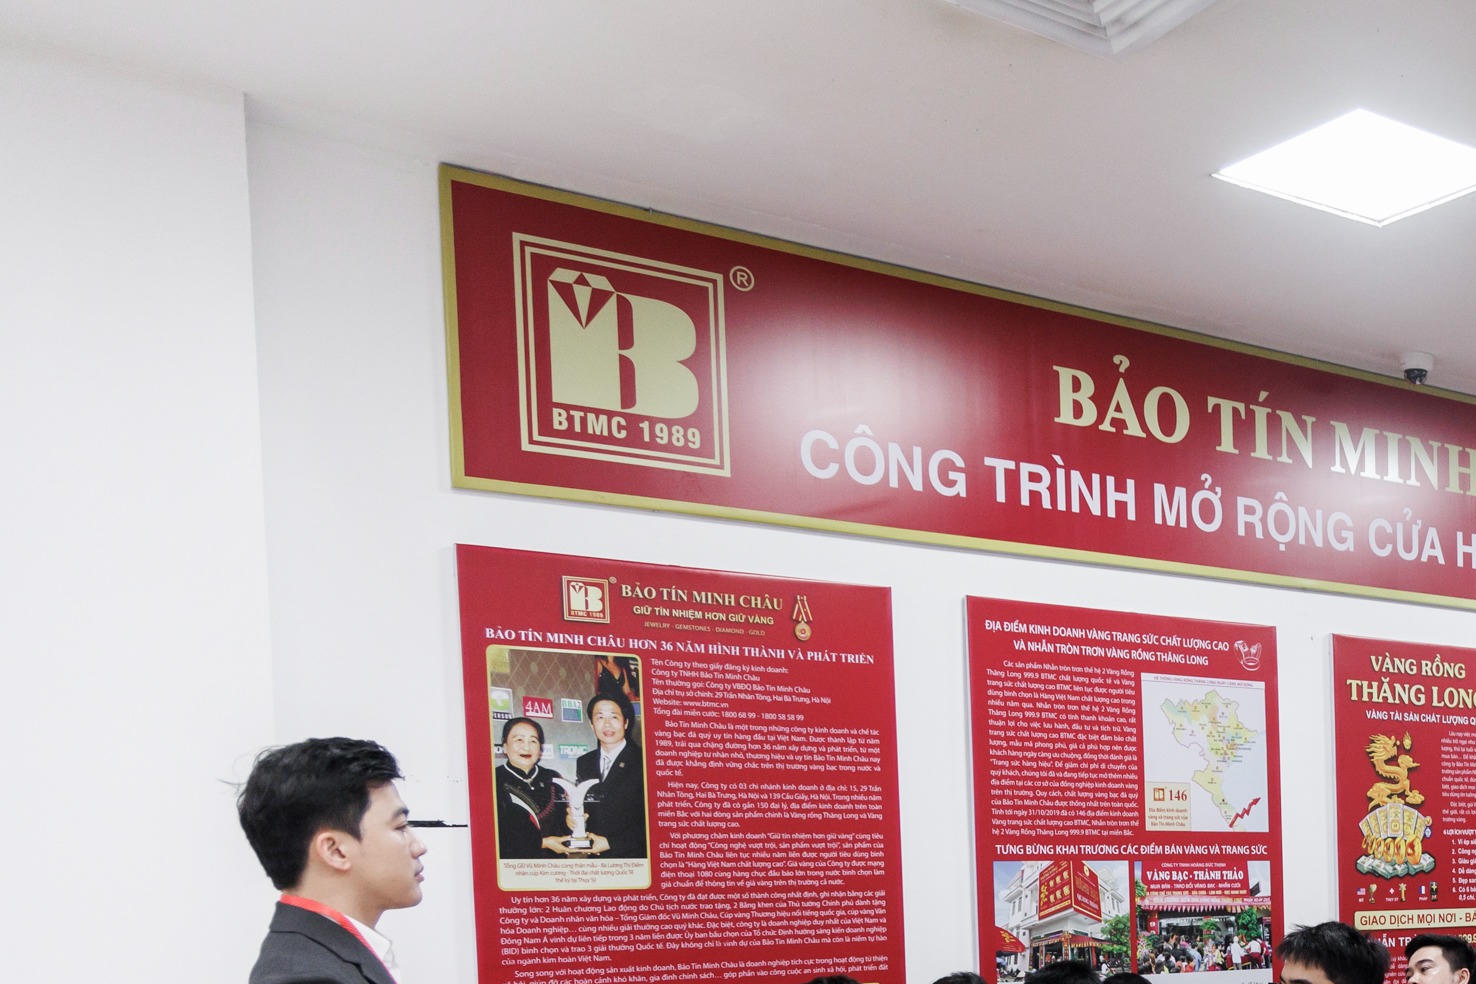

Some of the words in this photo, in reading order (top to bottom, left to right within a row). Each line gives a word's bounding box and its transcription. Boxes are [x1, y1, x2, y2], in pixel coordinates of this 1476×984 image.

[1053, 355, 1190, 443] BẢO
[1208, 391, 1315, 468] TÍN
[553, 408, 627, 438] BTMC
[639, 420, 701, 449] 1989
[802, 426, 966, 497] CÔNG
[984, 454, 1136, 521] TRÌNH
[1154, 473, 1222, 532] MỞ
[1237, 492, 1354, 551] RỘNG
[1370, 508, 1445, 565] CỬA
[622, 583, 656, 599] BẢO
[660, 586, 687, 601] TÍN
[693, 591, 735, 606] MINH
[740, 594, 782, 610] CHÂU
[633, 605, 652, 614] GIỮ
[672, 609, 702, 620] NHIỆM
[705, 612, 726, 621] HƠN
[728, 613, 746, 622] GIỮ
[748, 614, 774, 624] VÀNG
[486, 626, 515, 640] BẢO
[518, 628, 542, 642] TÍN
[547, 633, 584, 644] MINH
[587, 635, 624, 648] CHÂU
[629, 639, 656, 649] HƠN
[661, 641, 673, 651] 36
[676, 641, 704, 653] NĂM
[709, 642, 739, 655] HÌNH
[743, 646, 784, 658] THÀNH
[788, 648, 804, 660] VÀ
[807, 650, 838, 662] PHÁT
[985, 620, 1002, 632] ĐỊA
[1029, 624, 1051, 635] KINH
[1053, 626, 1085, 638] DOANH
[1086, 628, 1110, 640] VÀNG
[1112, 632, 1140, 643] TRANG
[1142, 633, 1158, 645] SỨC
[1183, 638, 1211, 650] LƯỢNG
[1212, 641, 1229, 651] CAO
[1014, 639, 1026, 650] VÀ
[1055, 643, 1079, 654] TRÒN
[1080, 646, 1104, 656] TRƠN
[1106, 647, 1130, 659] VÀNG
[1186, 655, 1208, 665] LONG
[1371, 652, 1417, 674] VÀNG
[1422, 654, 1465, 678] RỒNG
[1347, 678, 1425, 705] THĂNG
[525, 701, 552, 714] 4AM
[1366, 709, 1388, 720] VÀNG
[1390, 710, 1402, 720] TÀI
[1169, 790, 1187, 801] 146
[995, 844, 1024, 854] TƯNG
[1026, 843, 1054, 854] BỪNG
[1056, 845, 1078, 854] KHAI
[1080, 844, 1118, 854] TRƯƠNG
[1121, 843, 1138, 854] CÁC
[1165, 844, 1182, 854] BÁN
[1184, 844, 1208, 854] VÀNG
[1209, 844, 1220, 854] VÀ
[1221, 846, 1250, 854] TRANG
[1251, 844, 1267, 854] SỨC
[1147, 869, 1170, 880] VÀNG
[1172, 871, 1188, 882] BẠC
[1360, 914, 1386, 926] GIAO
[1389, 913, 1414, 927] DỊCH
[1417, 913, 1436, 927] MỌI
[1438, 911, 1457, 923] NƠI
